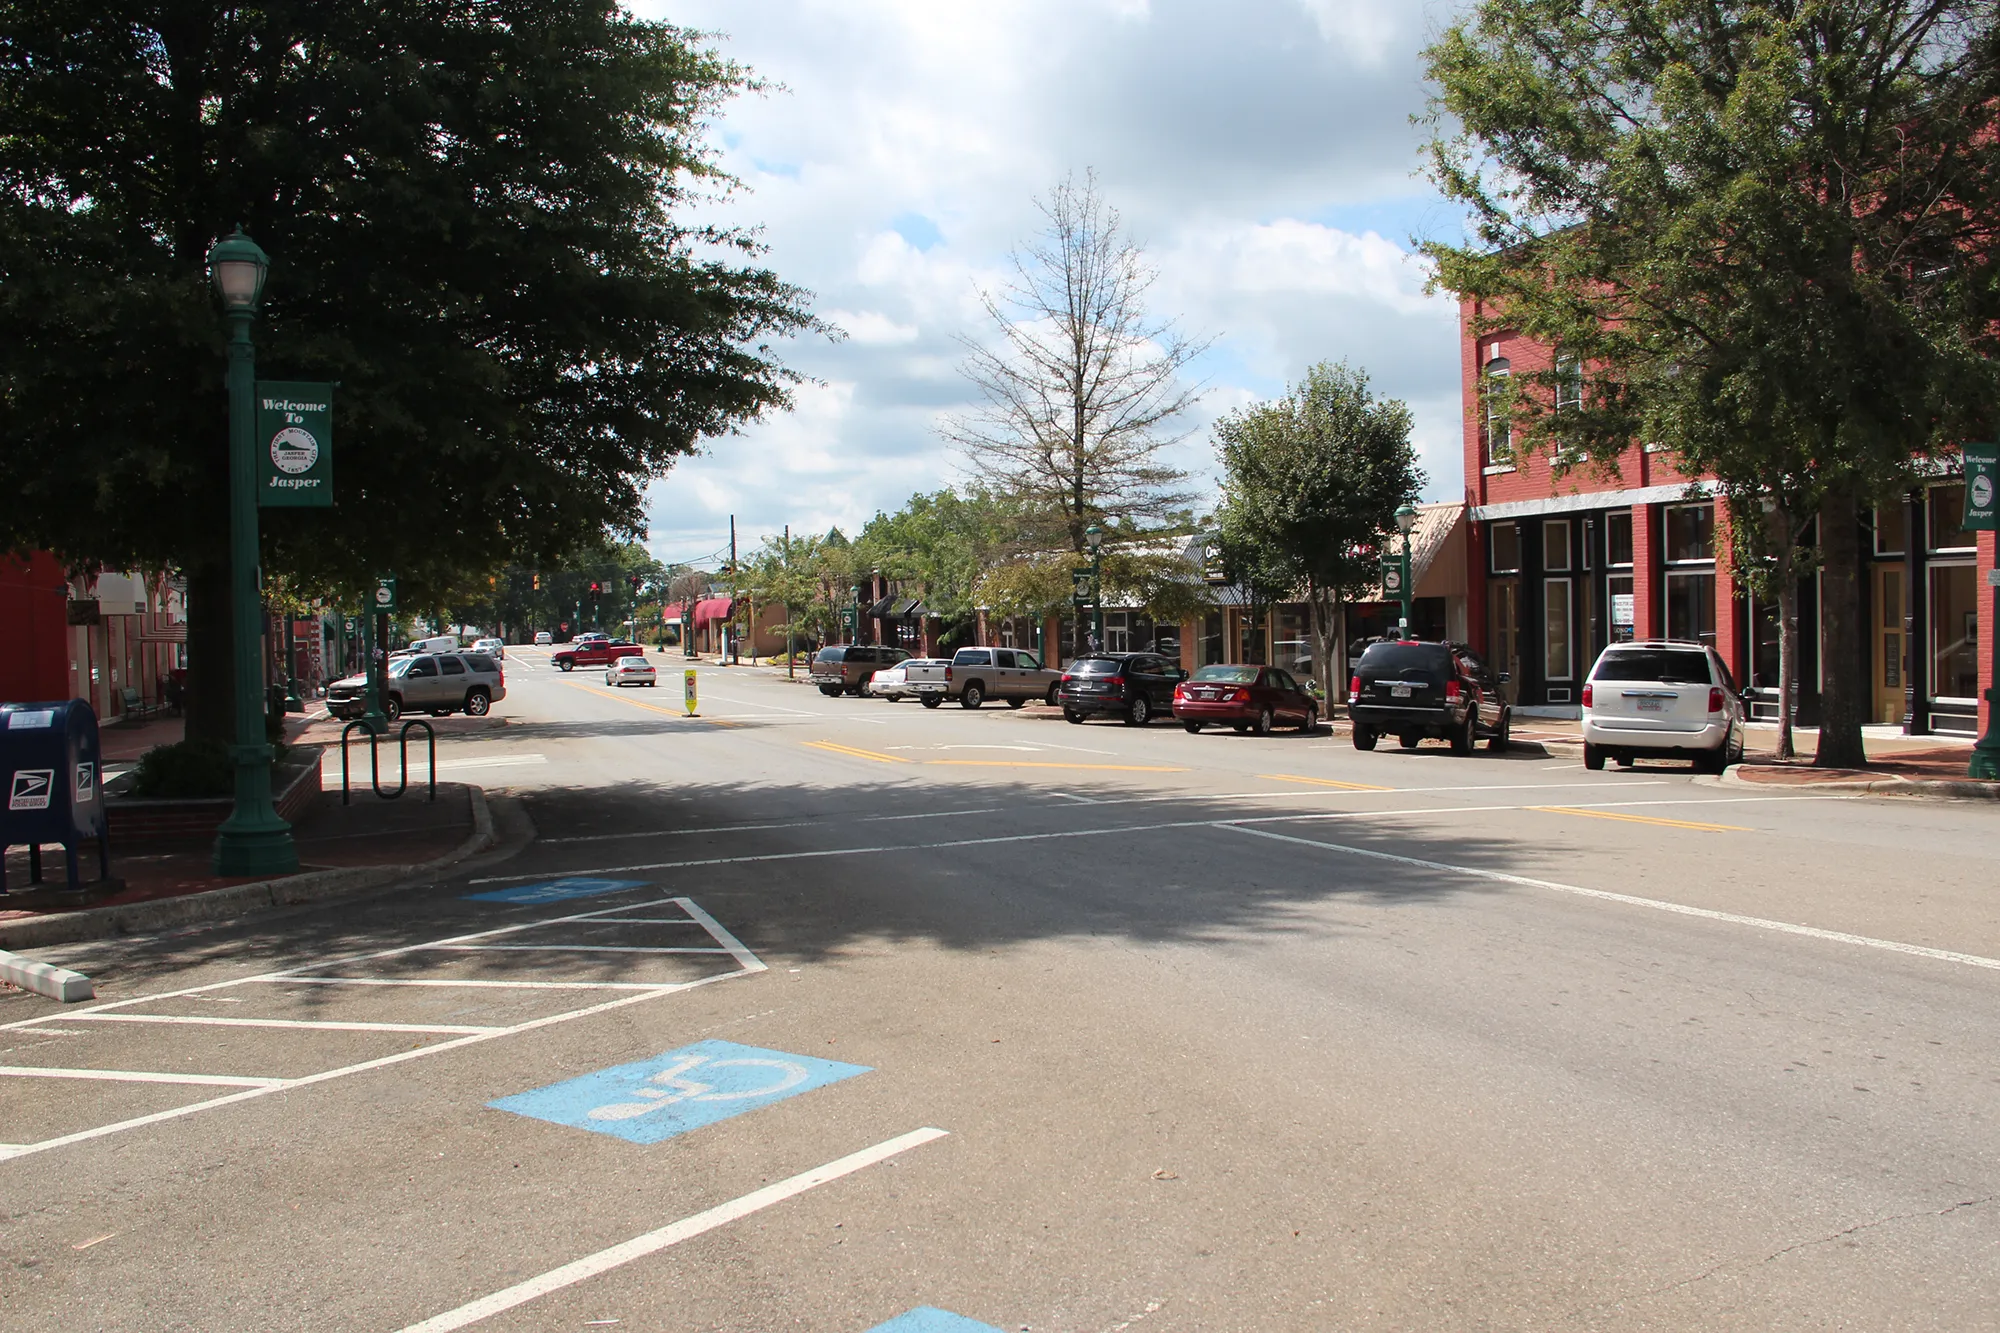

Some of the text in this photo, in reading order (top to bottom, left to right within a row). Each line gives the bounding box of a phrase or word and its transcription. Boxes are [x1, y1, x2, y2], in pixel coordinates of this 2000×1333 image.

[262, 399, 327, 412] Welcome
[285, 412, 304, 424] To
[272, 429, 317, 463] THE FIRST MOUNTAIN CITY
[1966, 455, 1996, 463] Welcome
[270, 476, 321, 490] Jasper
[1969, 509, 1992, 518] Jasper
